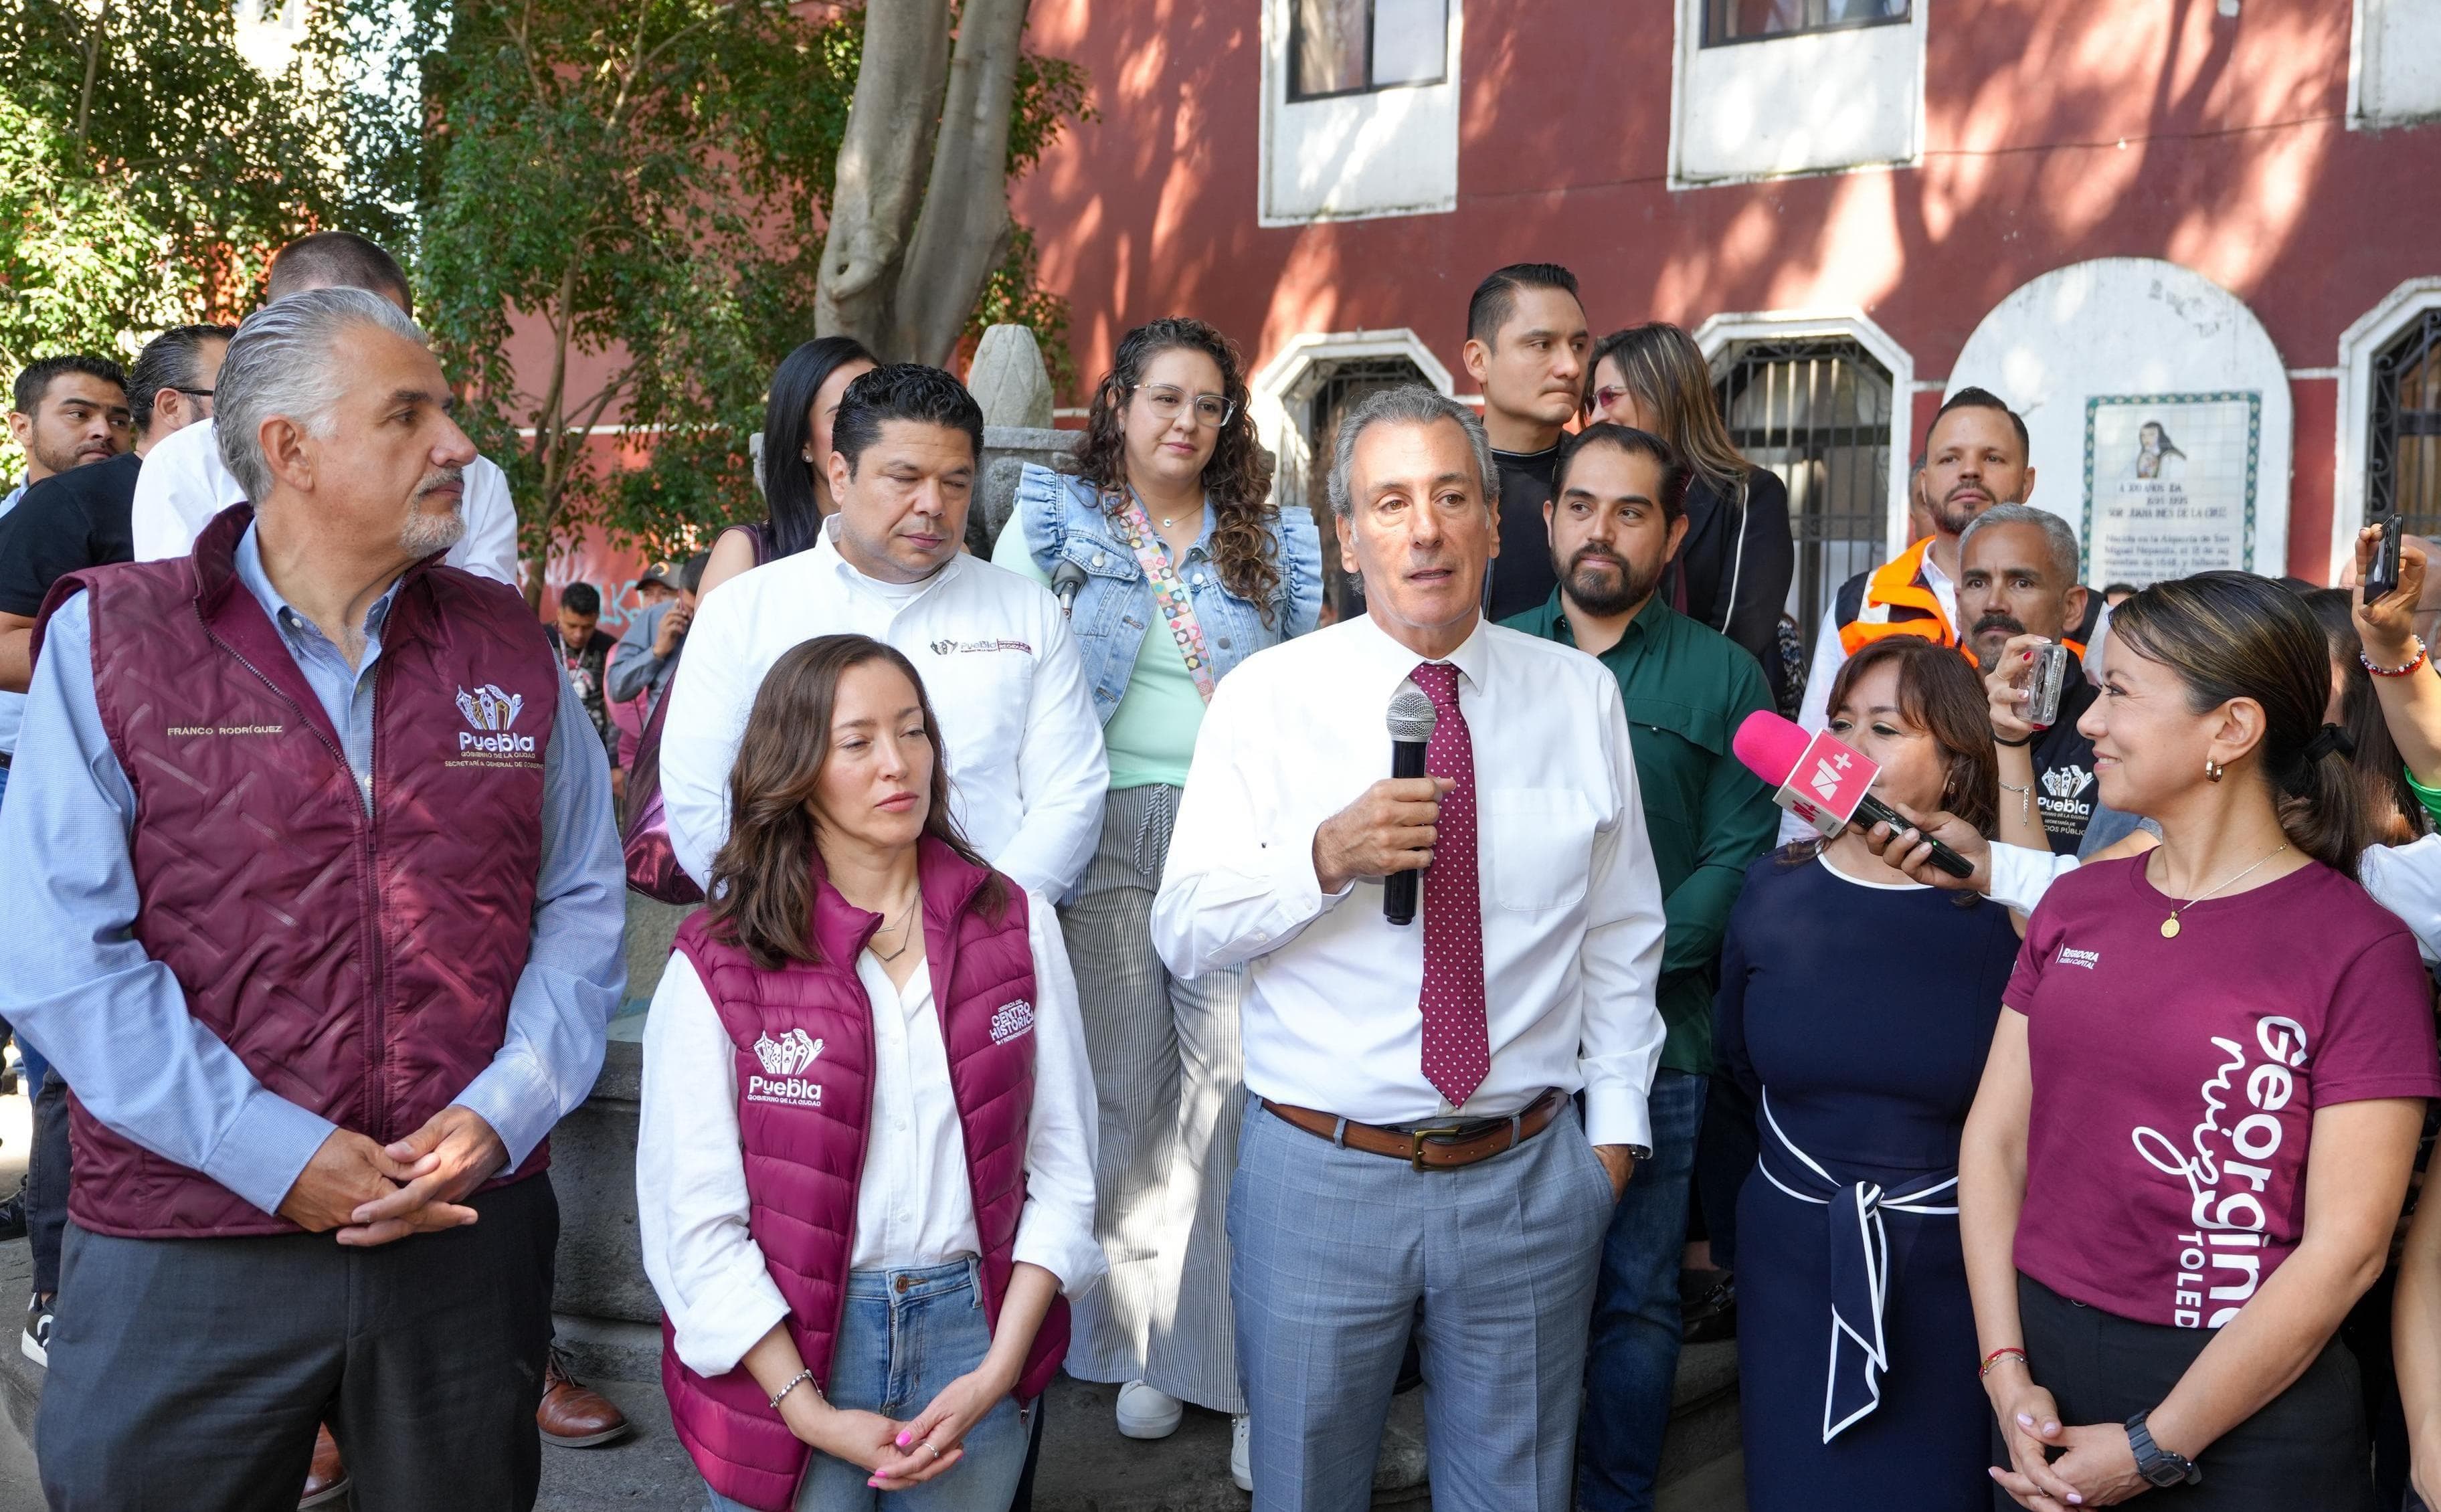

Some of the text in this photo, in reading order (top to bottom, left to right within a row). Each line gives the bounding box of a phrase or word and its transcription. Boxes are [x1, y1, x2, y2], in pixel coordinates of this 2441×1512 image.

[167, 727, 213, 736] FRANCO
[459, 732, 535, 752] Puebla
[2038, 797, 2090, 815] Puebla
[2060, 826, 2086, 836] PÚBLIC
[992, 1002, 1030, 1027] CENTRO
[749, 1076, 822, 1100] Puebla
[747, 1094, 780, 1102] GOBIERNO
[2175, 1231, 2205, 1328] TOLED
